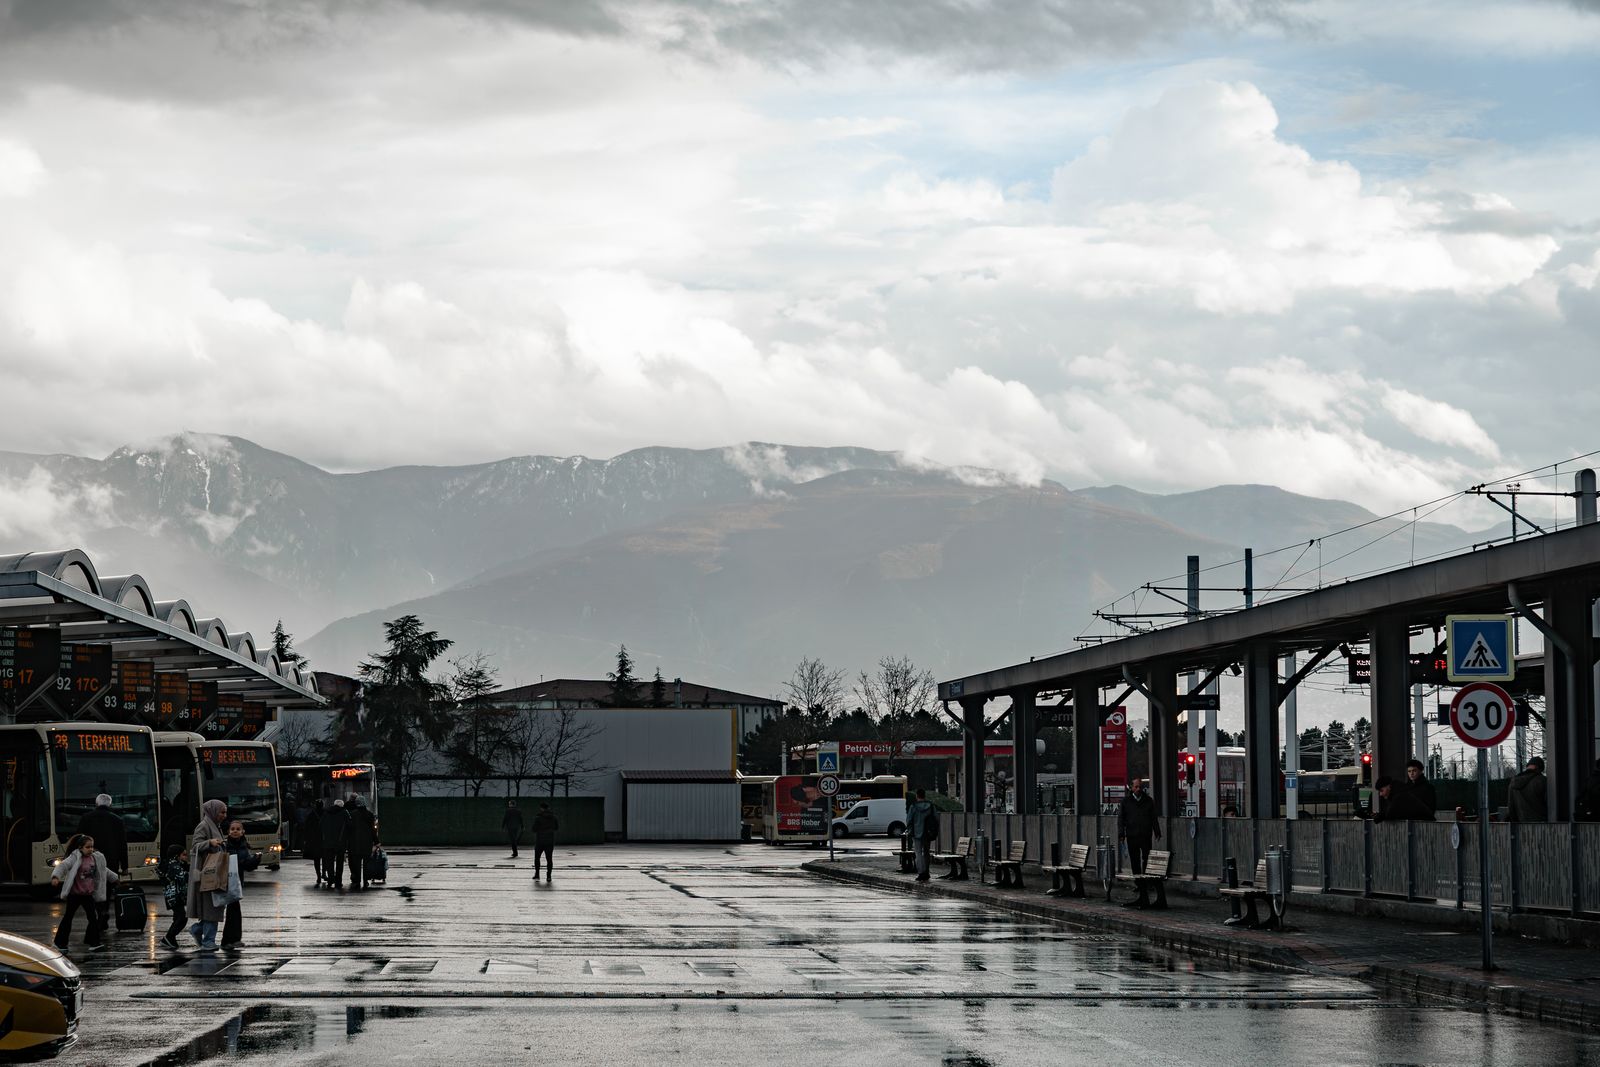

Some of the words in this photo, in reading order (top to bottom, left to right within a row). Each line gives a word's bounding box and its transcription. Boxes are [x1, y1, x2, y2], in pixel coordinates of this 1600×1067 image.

[18, 669, 34, 685] 17
[56, 677, 71, 690] 92
[76, 677, 99, 692] 17C
[104, 695, 117, 708] 93
[161, 702, 173, 713] 98
[1463, 701, 1502, 731] 30
[207, 721, 217, 731] 96
[845, 744, 872, 753] Petrol
[822, 780, 836, 790] 30
[787, 818, 800, 826] BRS
